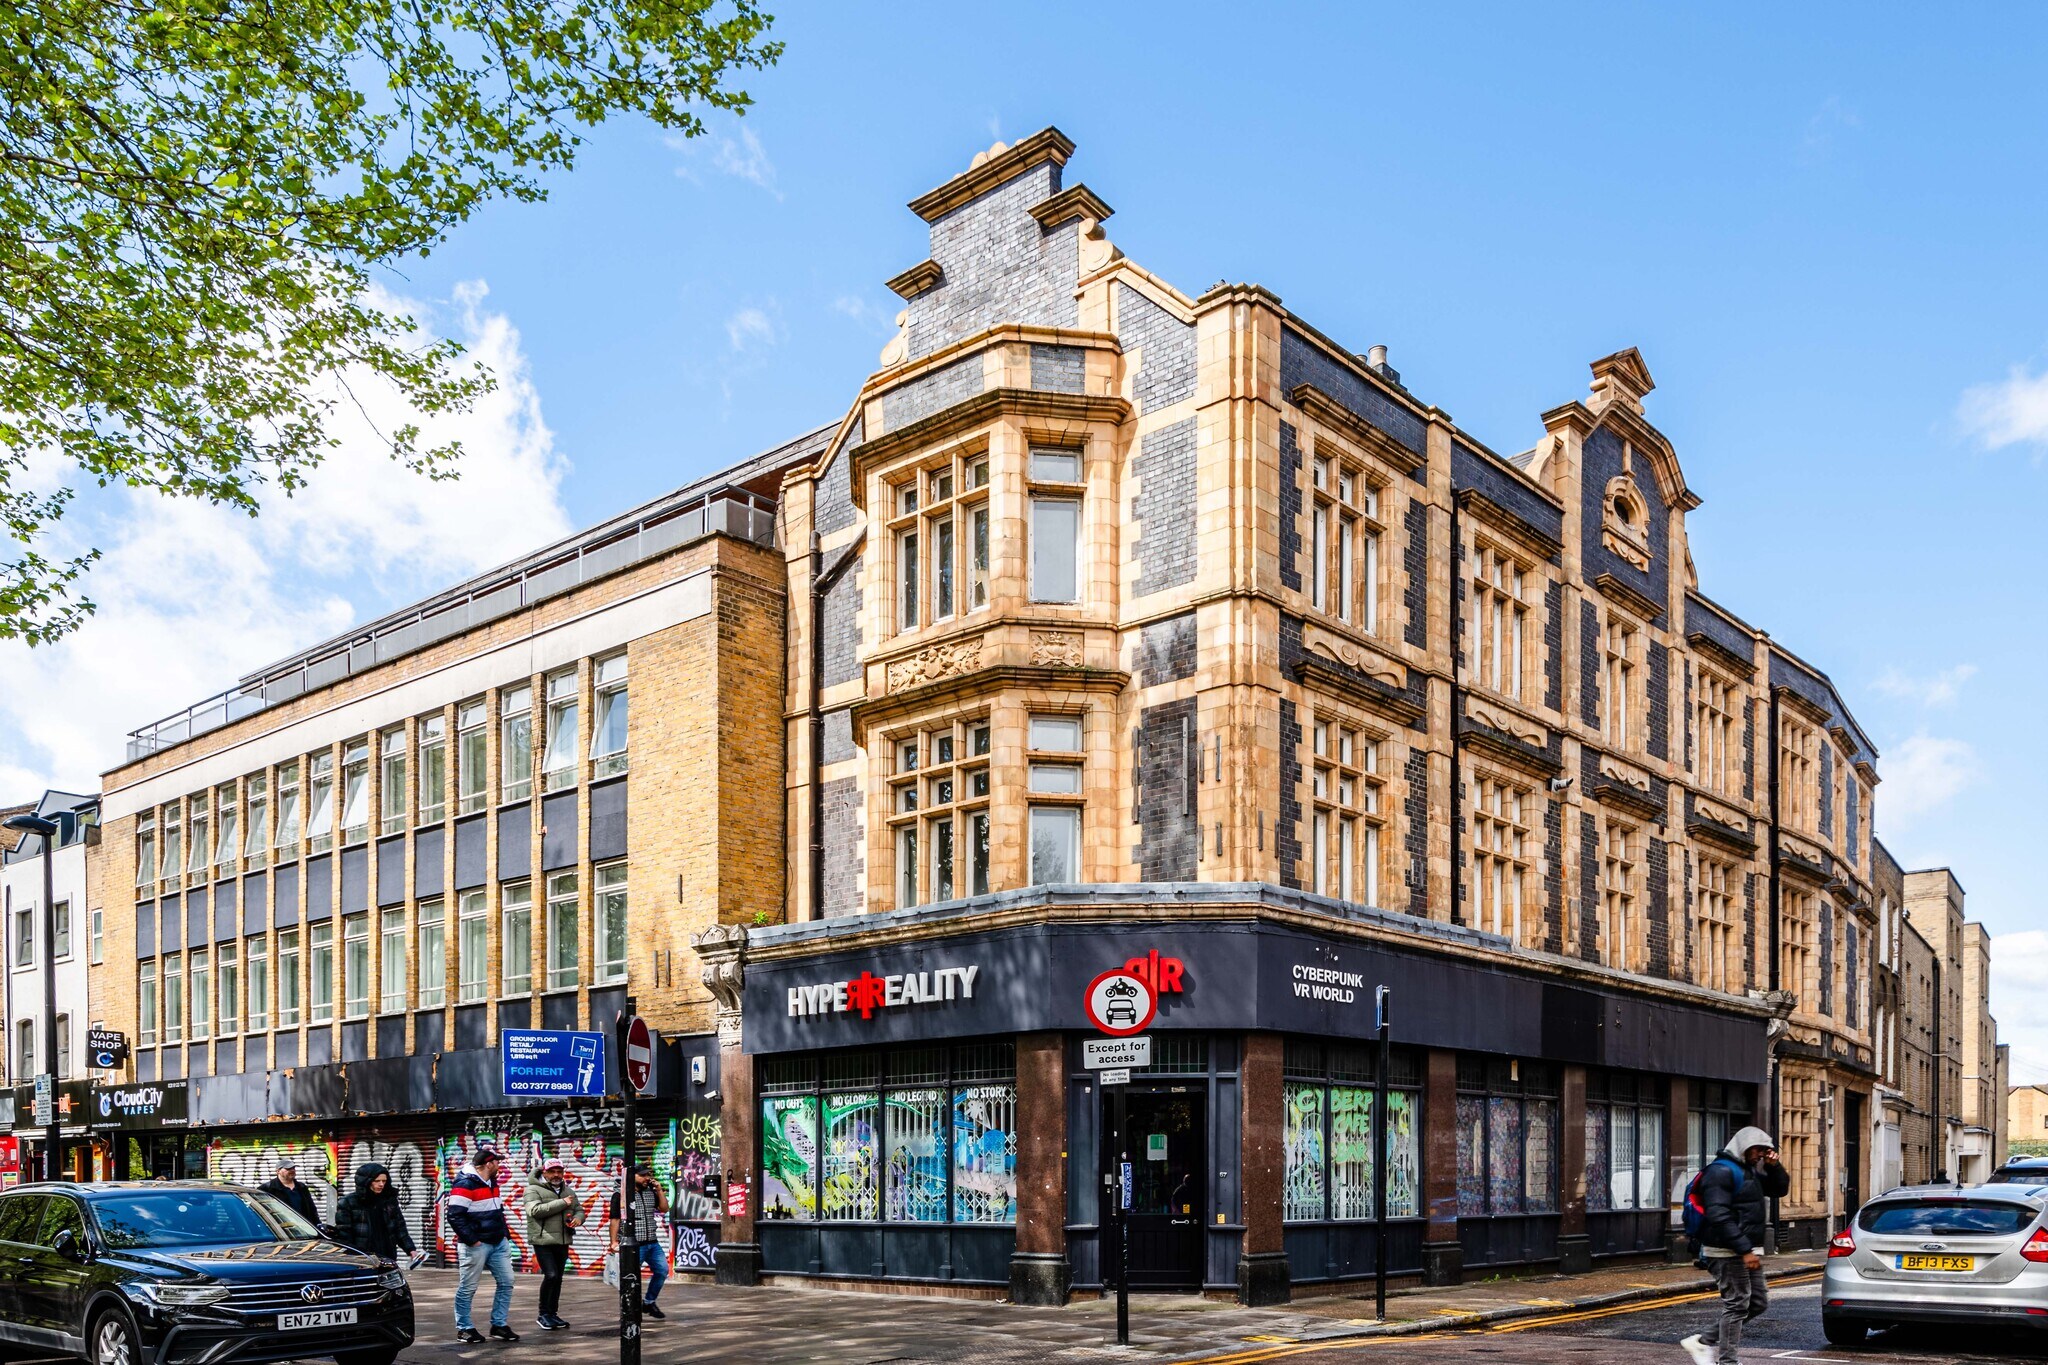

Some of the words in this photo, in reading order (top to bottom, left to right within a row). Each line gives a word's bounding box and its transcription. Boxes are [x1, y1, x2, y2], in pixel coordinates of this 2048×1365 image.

[1292, 964, 1364, 989] CYBERPUNK
[1293, 982, 1310, 998] VR
[1311, 984, 1355, 1004] WORLD
[91, 1031, 121, 1041] VAPE
[90, 1040, 122, 1050] SHOP
[1088, 1042, 1126, 1053] Except
[1130, 1041, 1146, 1051] for
[1098, 1054, 1136, 1064] access
[510, 1066, 534, 1076] FOR
[535, 1067, 564, 1076] RENT
[511, 1082, 529, 1090] 020
[529, 1082, 550, 1090] 7377
[551, 1082, 574, 1090] 8989
[113, 1088, 163, 1108] CloudCity
[894, 1091, 906, 1102] NO
[966, 1088, 979, 1099] NO
[980, 1086, 1007, 1099] STORY
[774, 1100, 788, 1110] NO
[788, 1099, 805, 1109] GUTS
[832, 1096, 843, 1106] NO
[844, 1094, 868, 1105] GLORY
[123, 1105, 155, 1115] VAPES
[1333, 1113, 1370, 1134] CAFE
[1333, 1142, 1369, 1164] BAR
[1907, 1256, 1937, 1268] BF13
[1942, 1257, 1969, 1268] FXS
[284, 1313, 321, 1328] EN72
[325, 1310, 351, 1324] TWV
